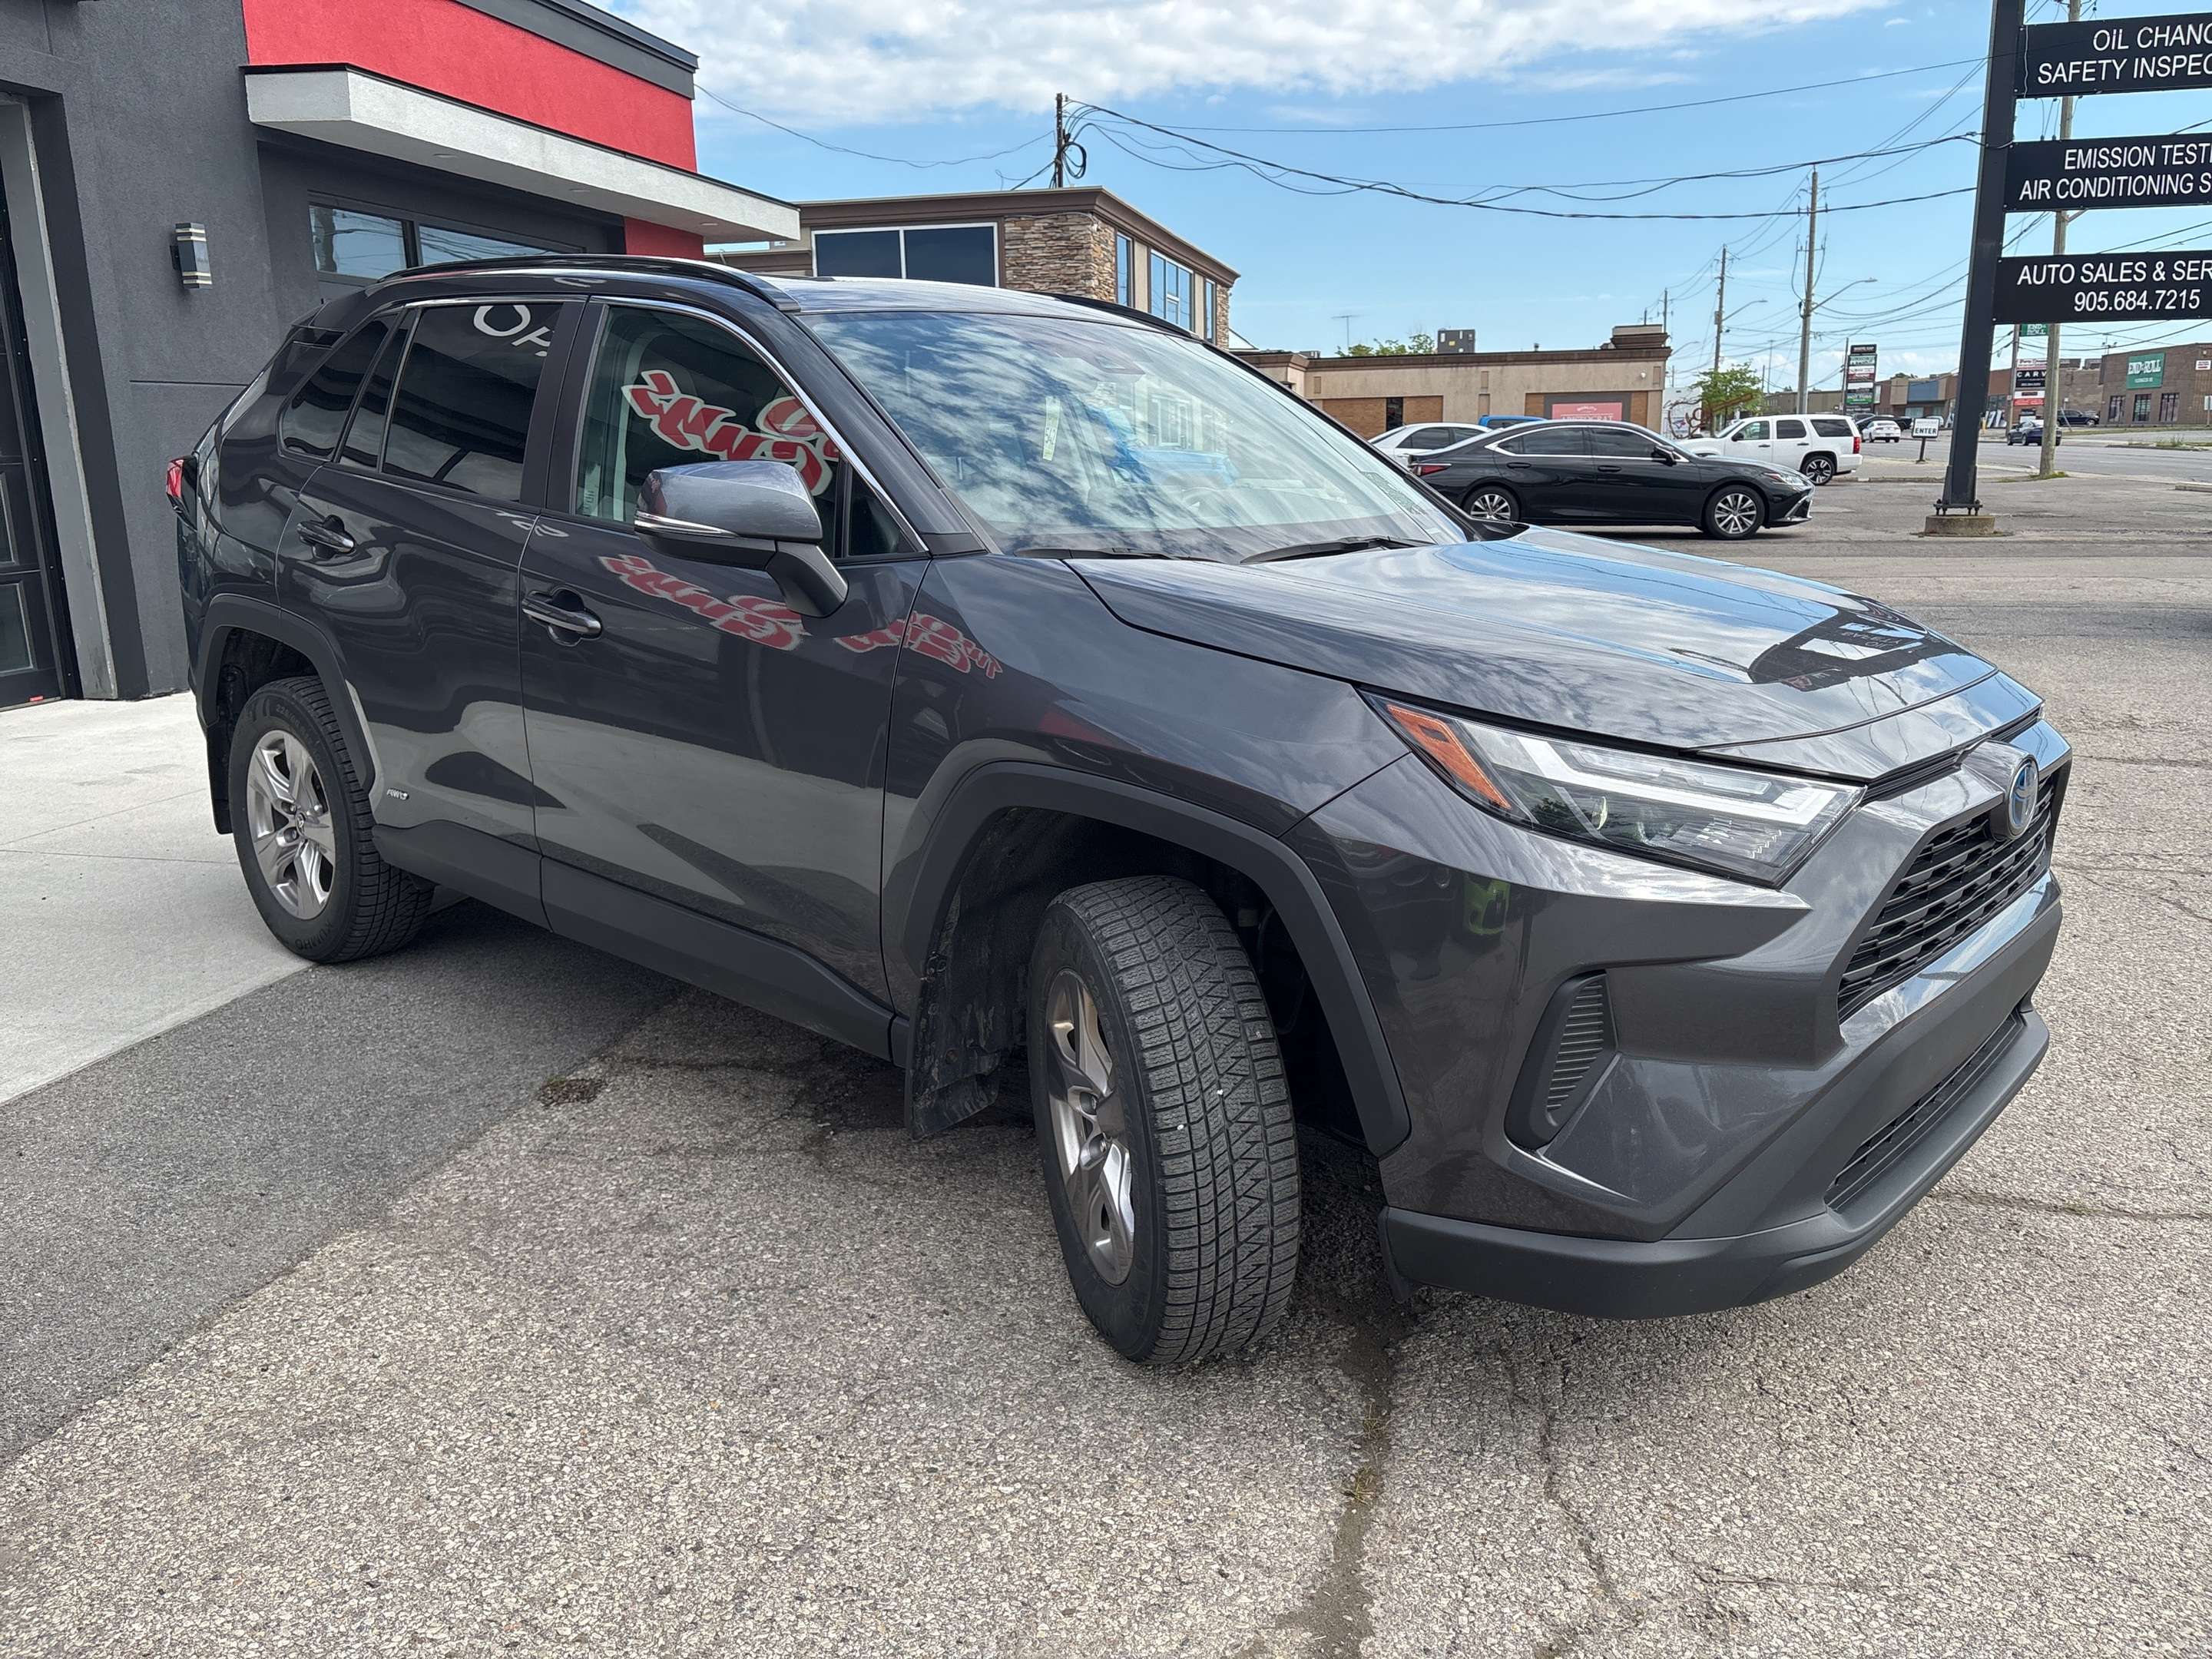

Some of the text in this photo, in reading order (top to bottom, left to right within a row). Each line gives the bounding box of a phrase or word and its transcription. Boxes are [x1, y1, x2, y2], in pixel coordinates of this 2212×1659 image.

[2093, 28, 2129, 51] OIL
[2038, 58, 2128, 84] SAFETY
[2065, 146, 2156, 170] EMISSION
[2019, 179, 2051, 200] AIR
[2056, 173, 2194, 199] CONDITIONING
[2017, 260, 2212, 285] AUTO SALES & SER
[2074, 289, 2200, 311] 905.684.7215
